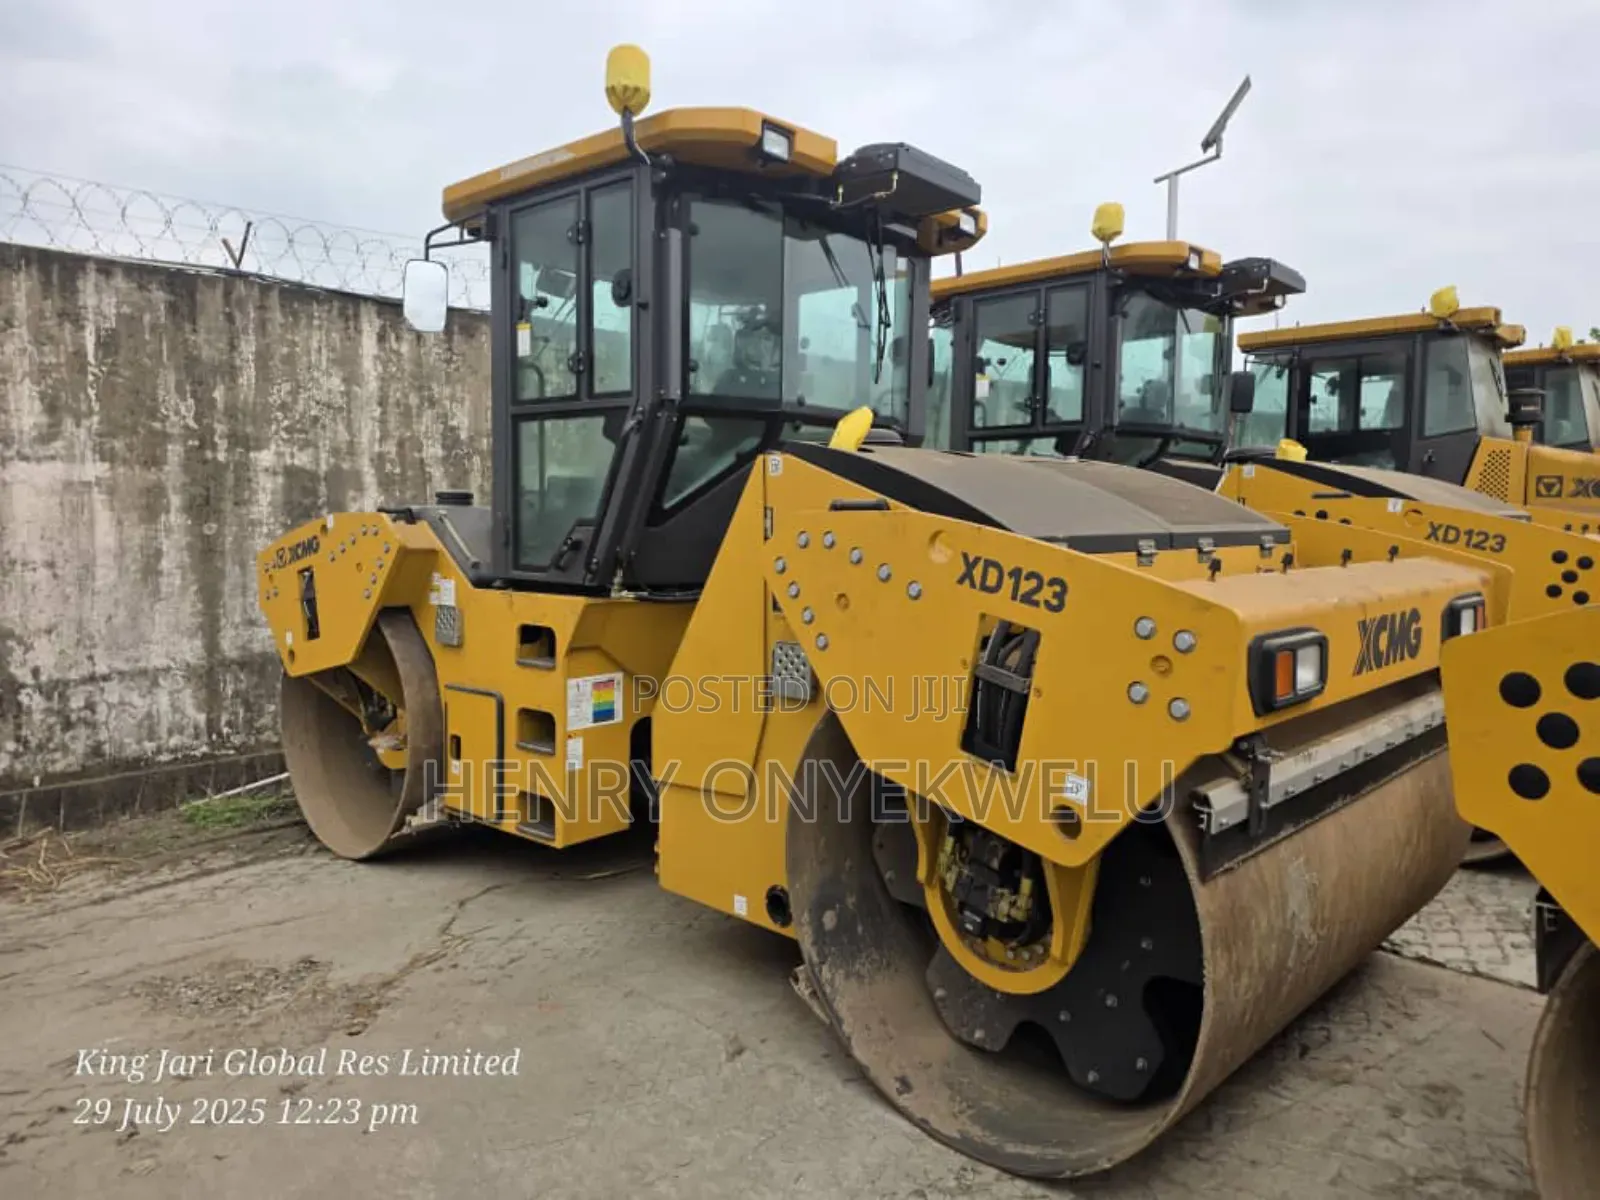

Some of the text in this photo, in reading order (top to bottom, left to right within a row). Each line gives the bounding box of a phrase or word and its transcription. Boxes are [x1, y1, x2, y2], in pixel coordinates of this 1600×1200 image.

[1425, 521, 1507, 553] XD123
[956, 551, 1069, 613] XD123
[1353, 607, 1422, 676] XCMG
